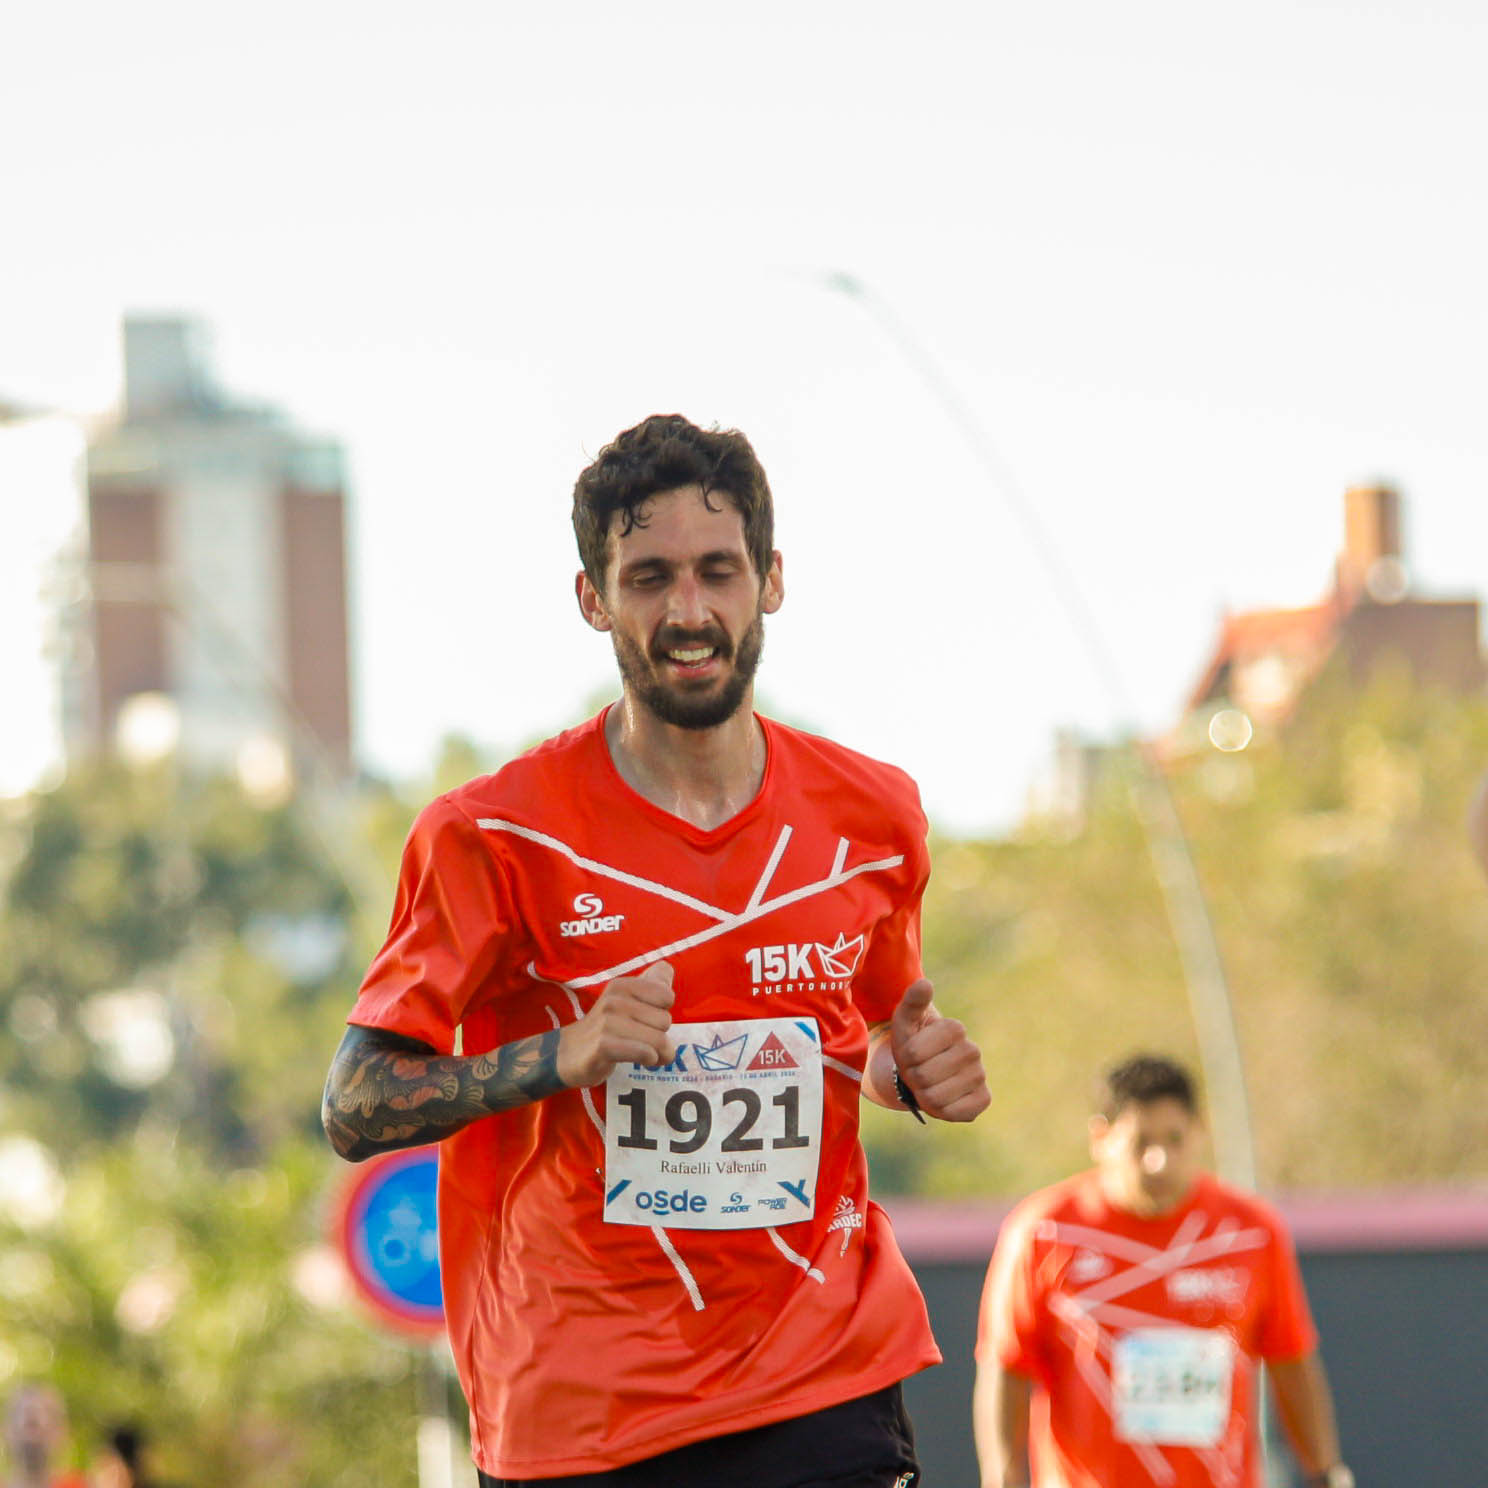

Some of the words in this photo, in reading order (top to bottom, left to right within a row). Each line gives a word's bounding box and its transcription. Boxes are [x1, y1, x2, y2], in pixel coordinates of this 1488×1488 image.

[745, 943, 815, 984] 15K
[752, 982, 815, 996] PUERTO
[820, 981, 849, 991] NOR
[759, 1049, 786, 1065] 15K
[618, 1086, 810, 1154] 1921
[661, 1160, 711, 1174] Rafaelli
[635, 1189, 708, 1215] osde
